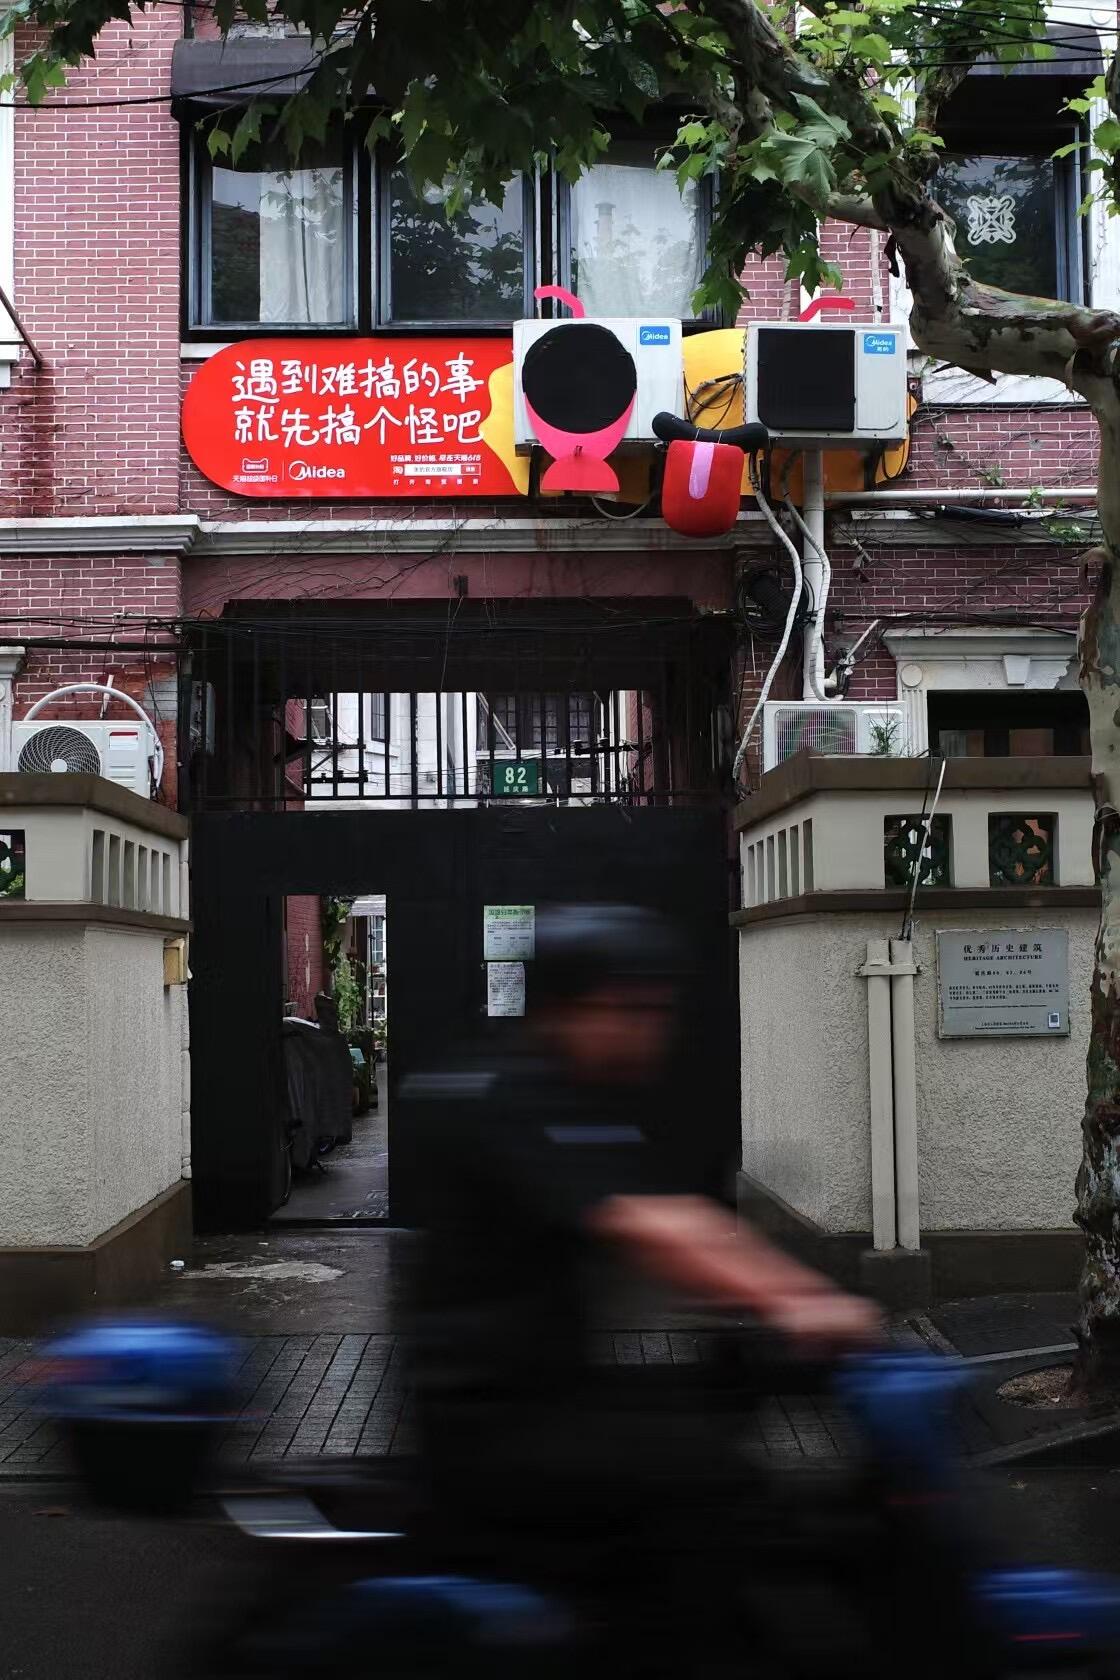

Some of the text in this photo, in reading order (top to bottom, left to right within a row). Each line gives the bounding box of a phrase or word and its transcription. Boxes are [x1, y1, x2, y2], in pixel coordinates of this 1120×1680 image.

[643, 331, 669, 340] Midea
[231, 352, 484, 403] 遇到难搞的事
[234, 404, 484, 447] 就先搞个怪吧
[290, 461, 346, 480] Midea
[505, 767, 526, 784] 82
[963, 943, 1042, 954] 优秀历史建筑
